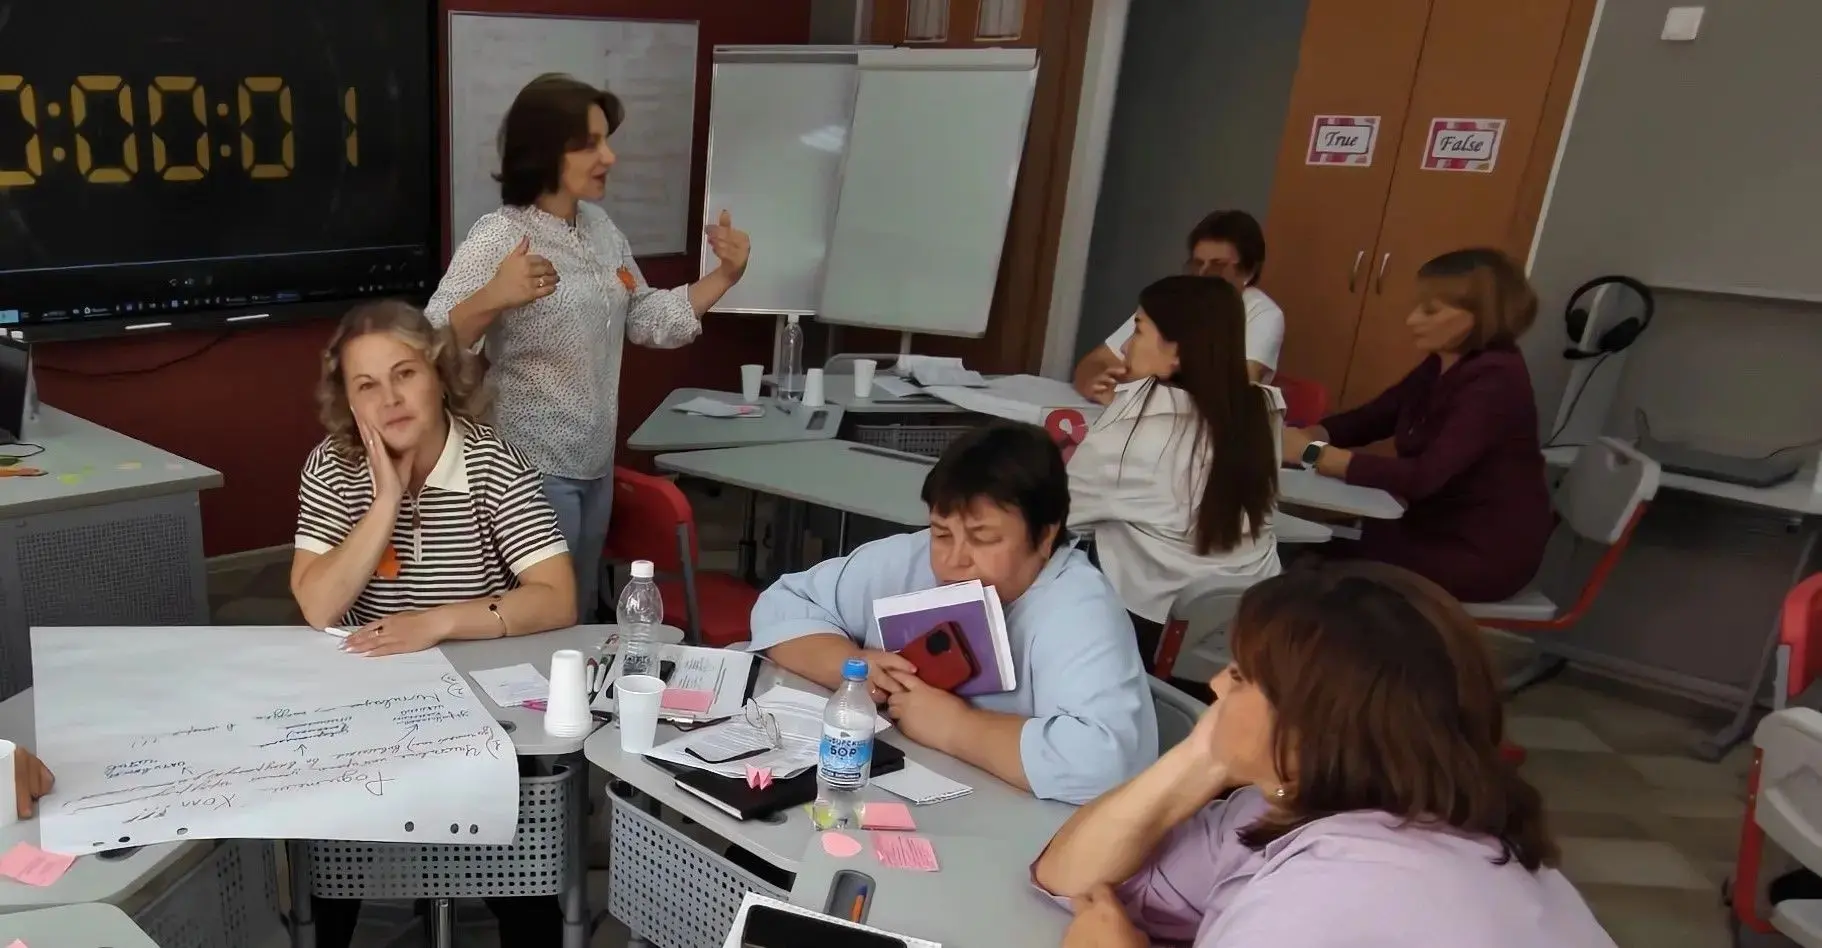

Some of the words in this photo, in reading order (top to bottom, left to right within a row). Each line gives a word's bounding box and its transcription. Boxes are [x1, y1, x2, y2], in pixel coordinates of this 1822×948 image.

[1324, 131, 1358, 147] True
[1439, 135, 1485, 152] False
[830, 746, 857, 758] БОР
